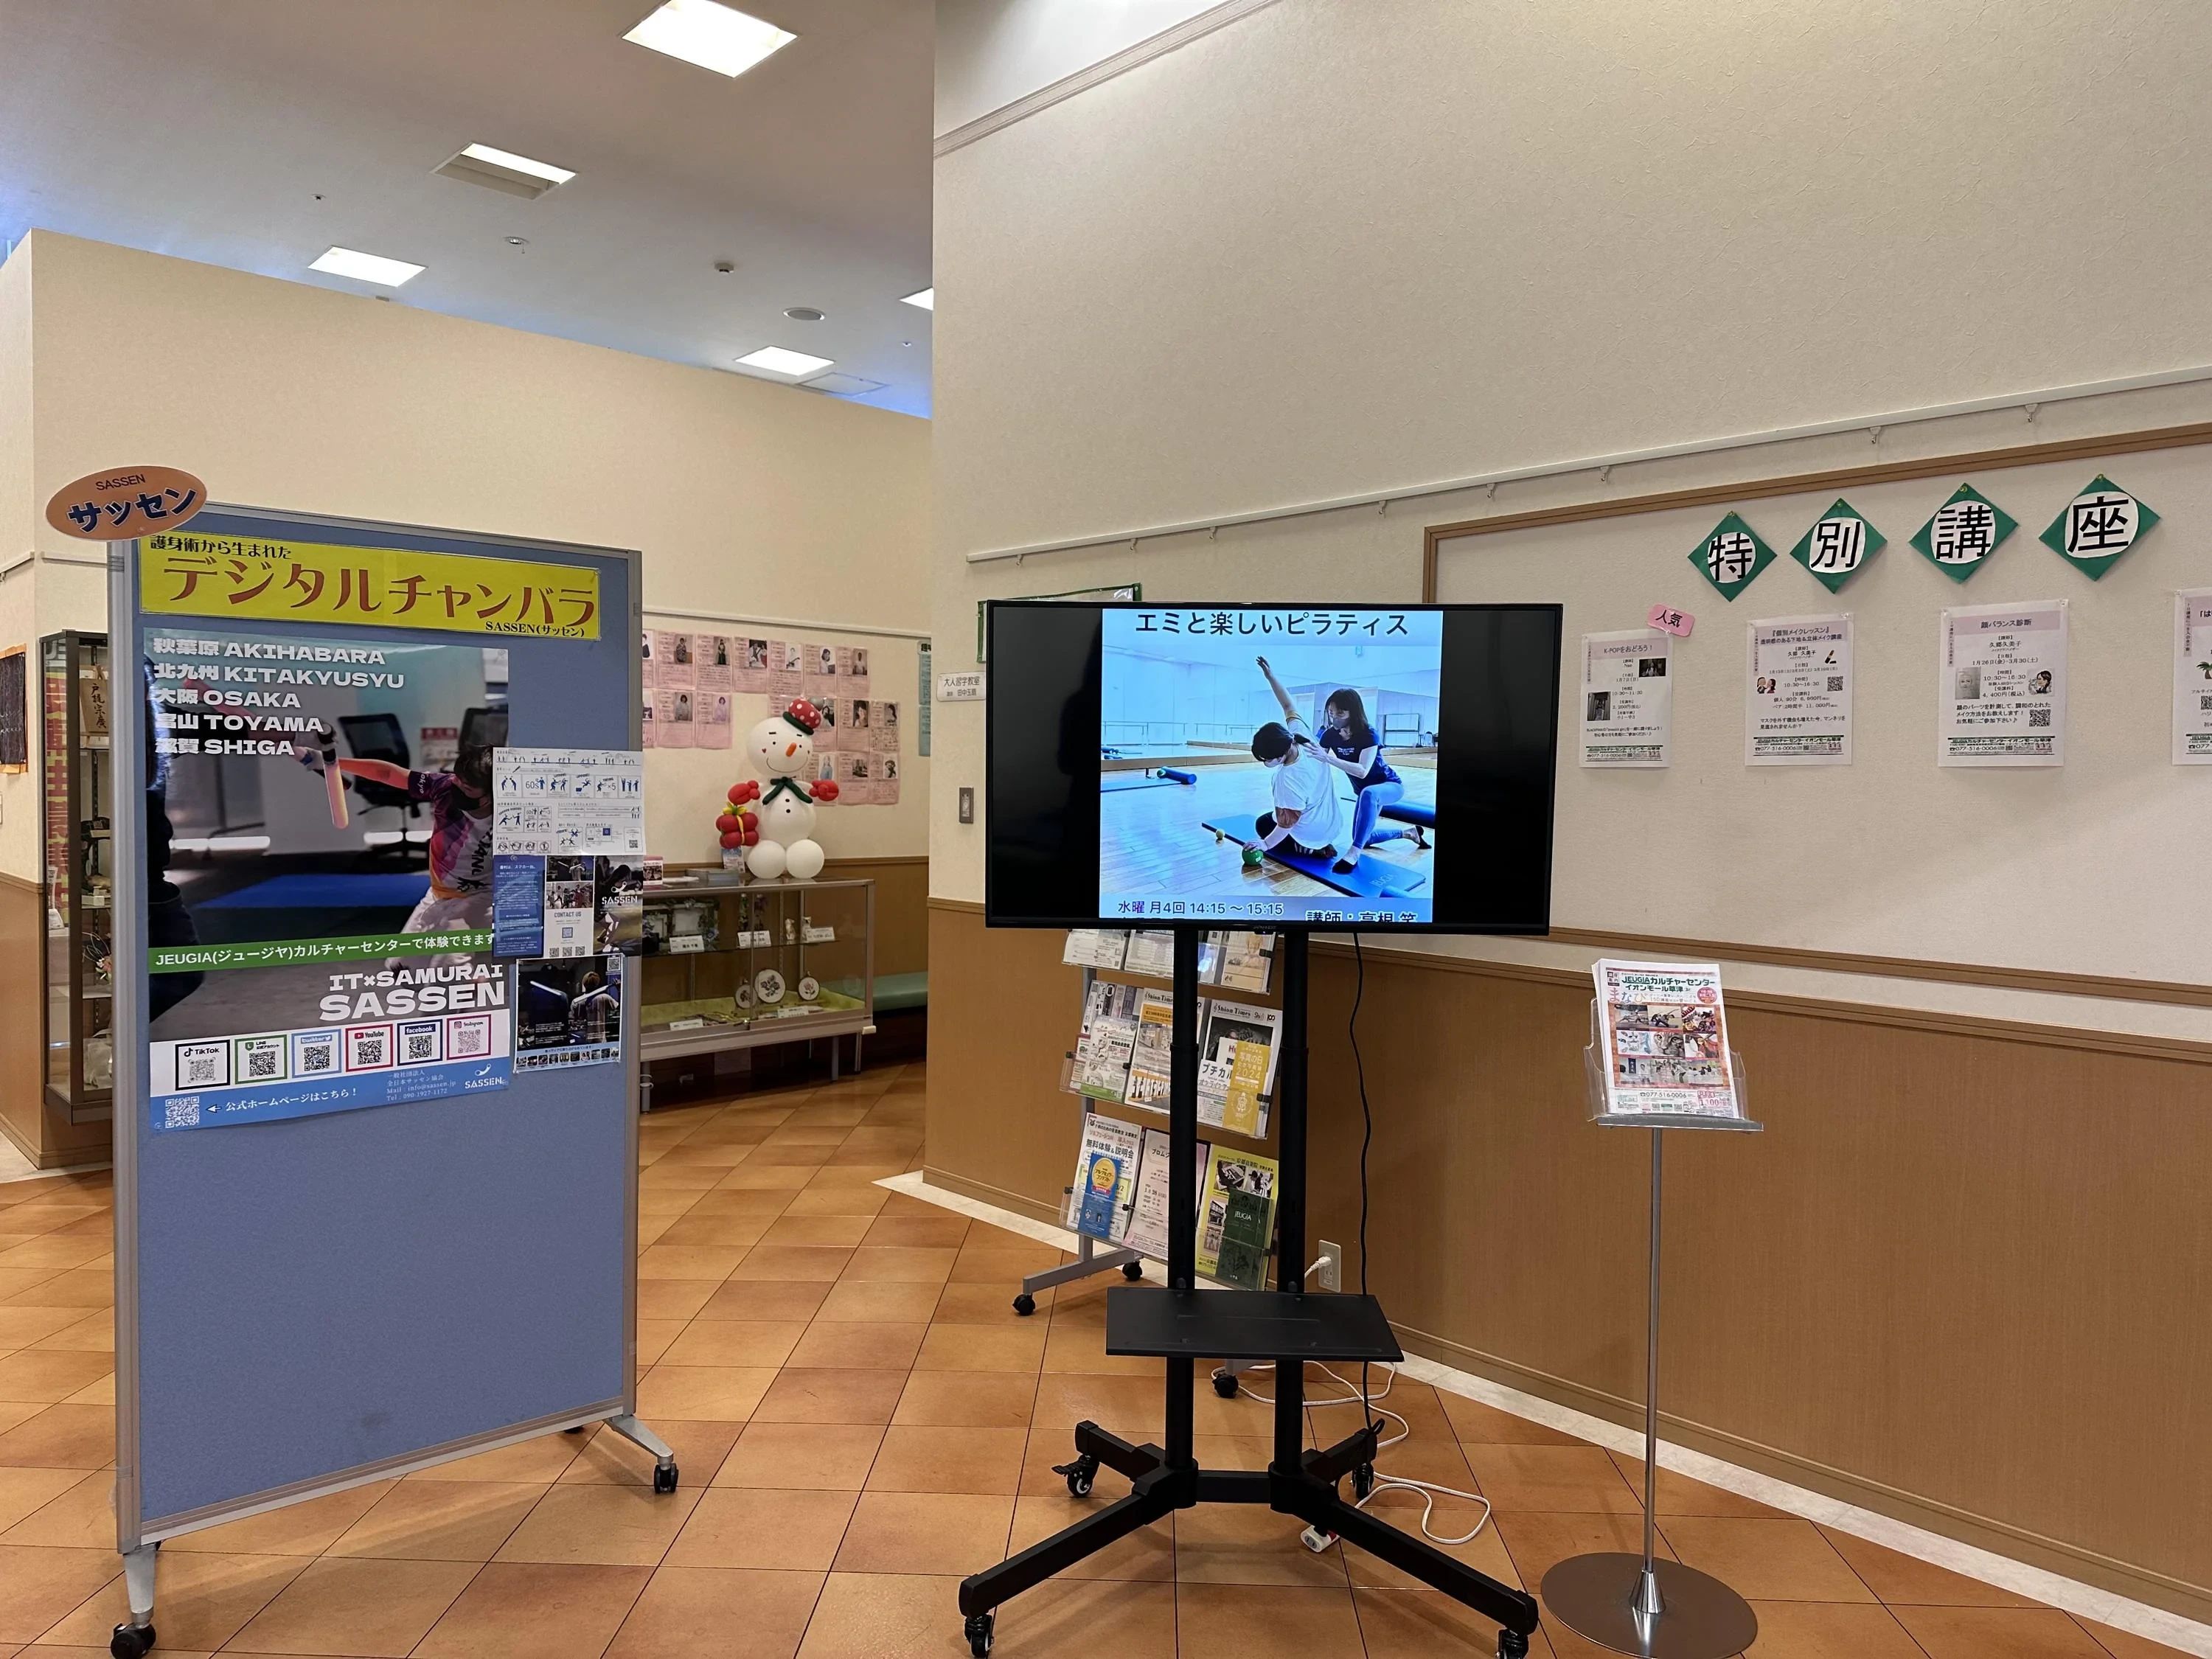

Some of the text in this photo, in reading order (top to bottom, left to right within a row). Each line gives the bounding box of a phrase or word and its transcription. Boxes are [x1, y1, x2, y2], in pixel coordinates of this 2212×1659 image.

[96, 474, 145, 490] SASSEN
[67, 487, 198, 533] サッセン
[150, 535, 292, 560] 護身術から生まれた
[164, 556, 595, 627] デジタルチャンバラ
[1135, 611, 1409, 637] エミと楽しいピラティス
[1655, 609, 1683, 627] 人気
[485, 621, 585, 638] SASSEN(サッセン)
[153, 637, 386, 665] 秋葉原 AKIHABARA
[154, 662, 405, 689] 北九州 KITAKYUSYU
[156, 688, 301, 708] 大阪 OSAKA
[156, 713, 324, 733] 富山 TOYAMA
[156, 738, 295, 757] 滋賀 SHIGA
[601, 895, 638, 905] SASSEN
[1117, 900, 1145, 914] 水曜
[1150, 901, 1185, 915] 月4回
[1189, 902, 1225, 914] 14:15
[1247, 902, 1284, 915] 15:15
[319, 981, 505, 1022] SASSEN
[406, 1026, 433, 1034] facebook
[195, 1047, 220, 1055] TikTok
[465, 1077, 502, 1089] SASSEN
[1237, 1068, 1261, 1079] 2024
[226, 1088, 356, 1112] 公式ホームページはこちら！
